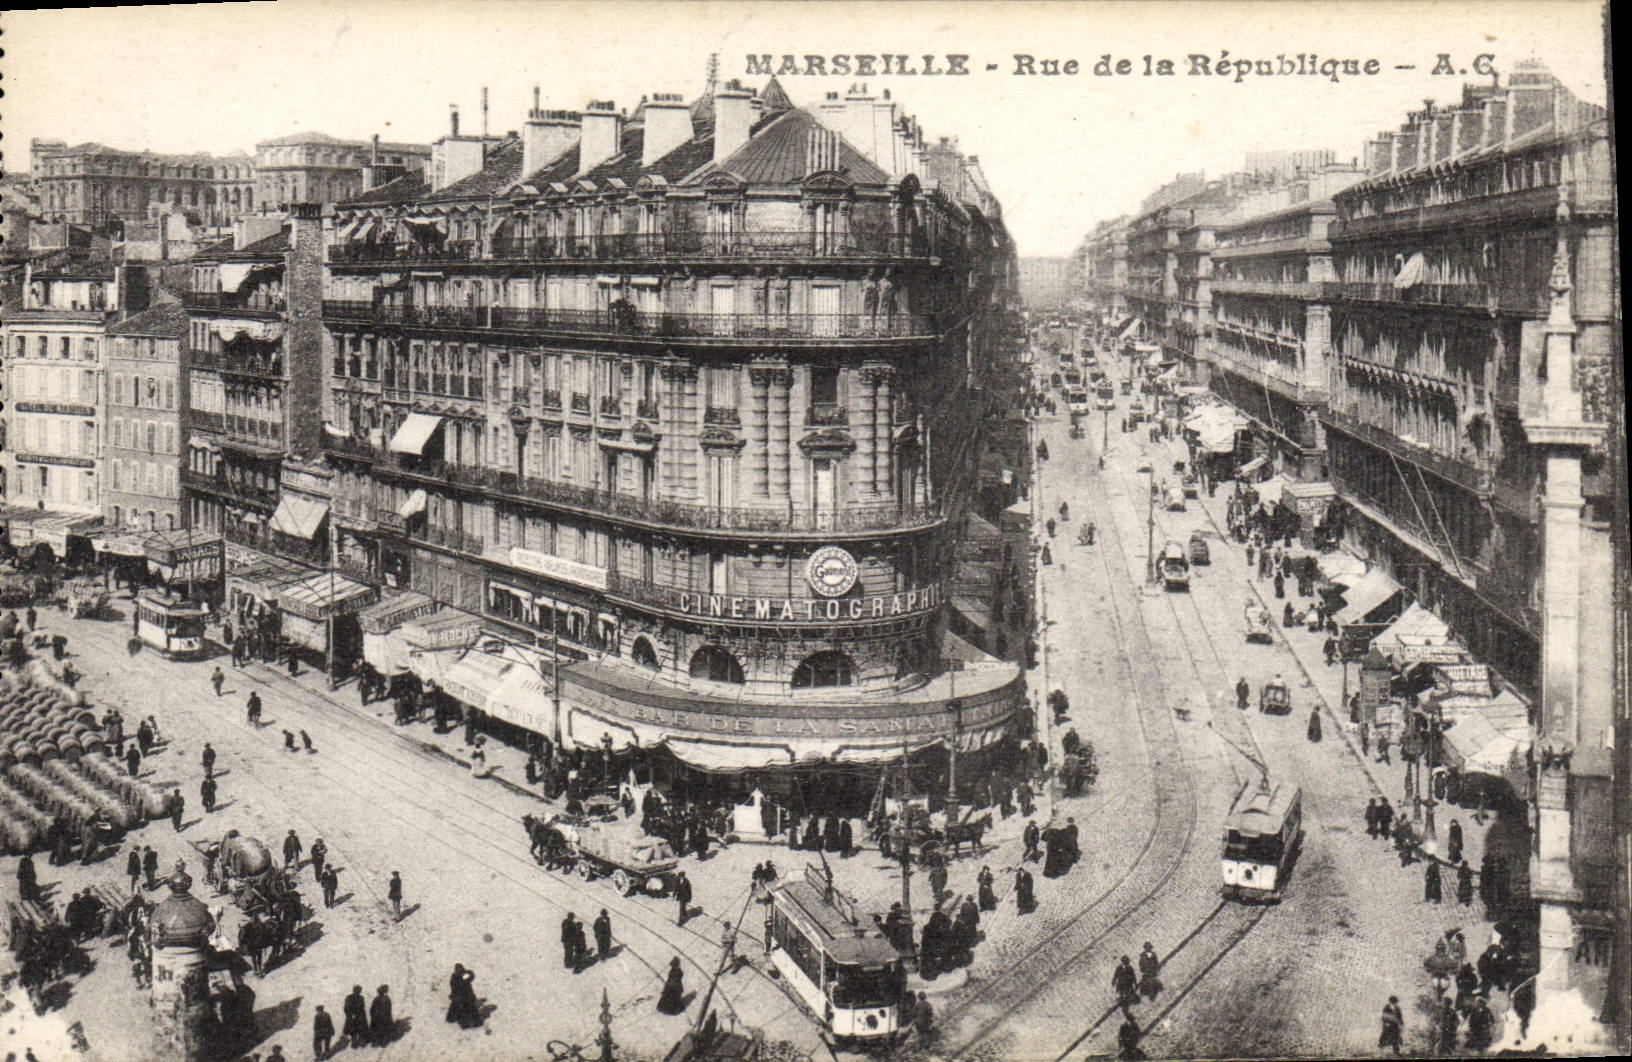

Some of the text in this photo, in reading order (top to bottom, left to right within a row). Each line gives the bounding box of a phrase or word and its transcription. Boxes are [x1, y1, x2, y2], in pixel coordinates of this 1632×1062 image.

[633, 704, 692, 727] BAR
[709, 717, 753, 732] DE
[773, 719, 823, 734] LA
